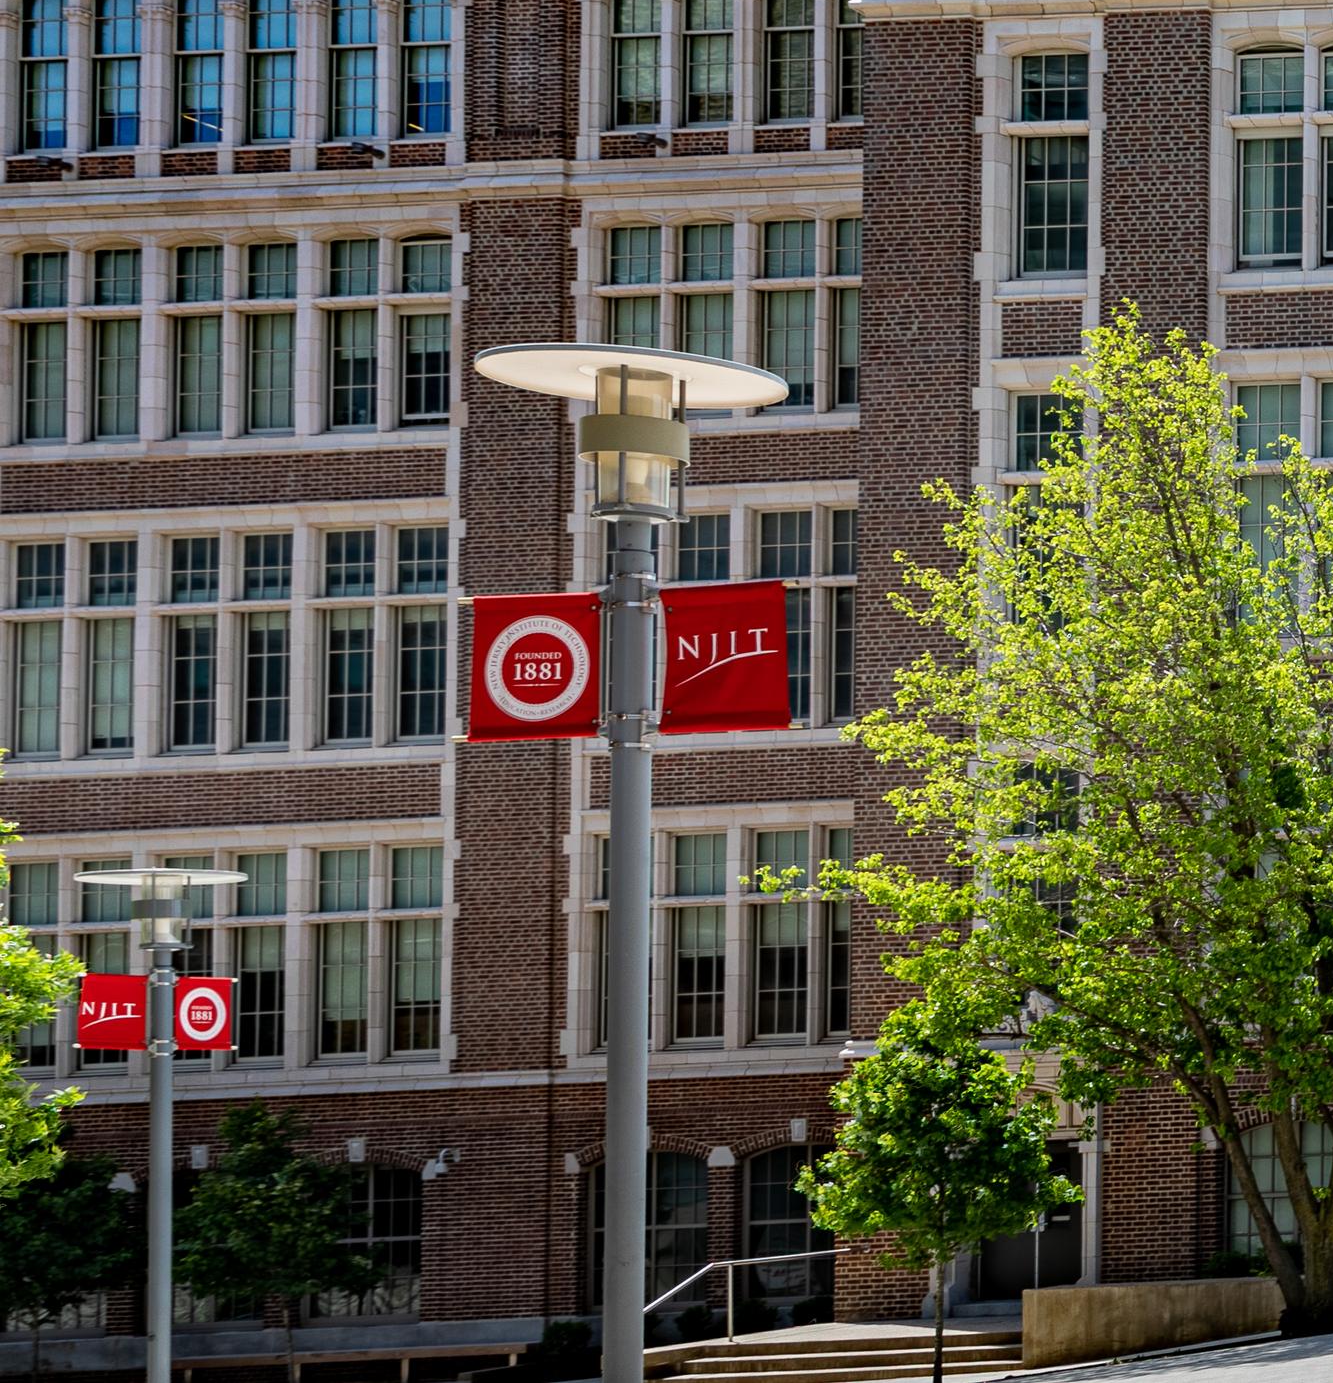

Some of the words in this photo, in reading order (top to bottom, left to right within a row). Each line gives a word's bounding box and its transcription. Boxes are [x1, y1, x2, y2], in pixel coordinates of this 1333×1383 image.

[677, 628, 768, 665] NJIT
[514, 651, 562, 660] FOUNDED
[513, 662, 562, 680] 1881
[82, 1001, 136, 1018] NJIT
[191, 1010, 212, 1020] 1881
